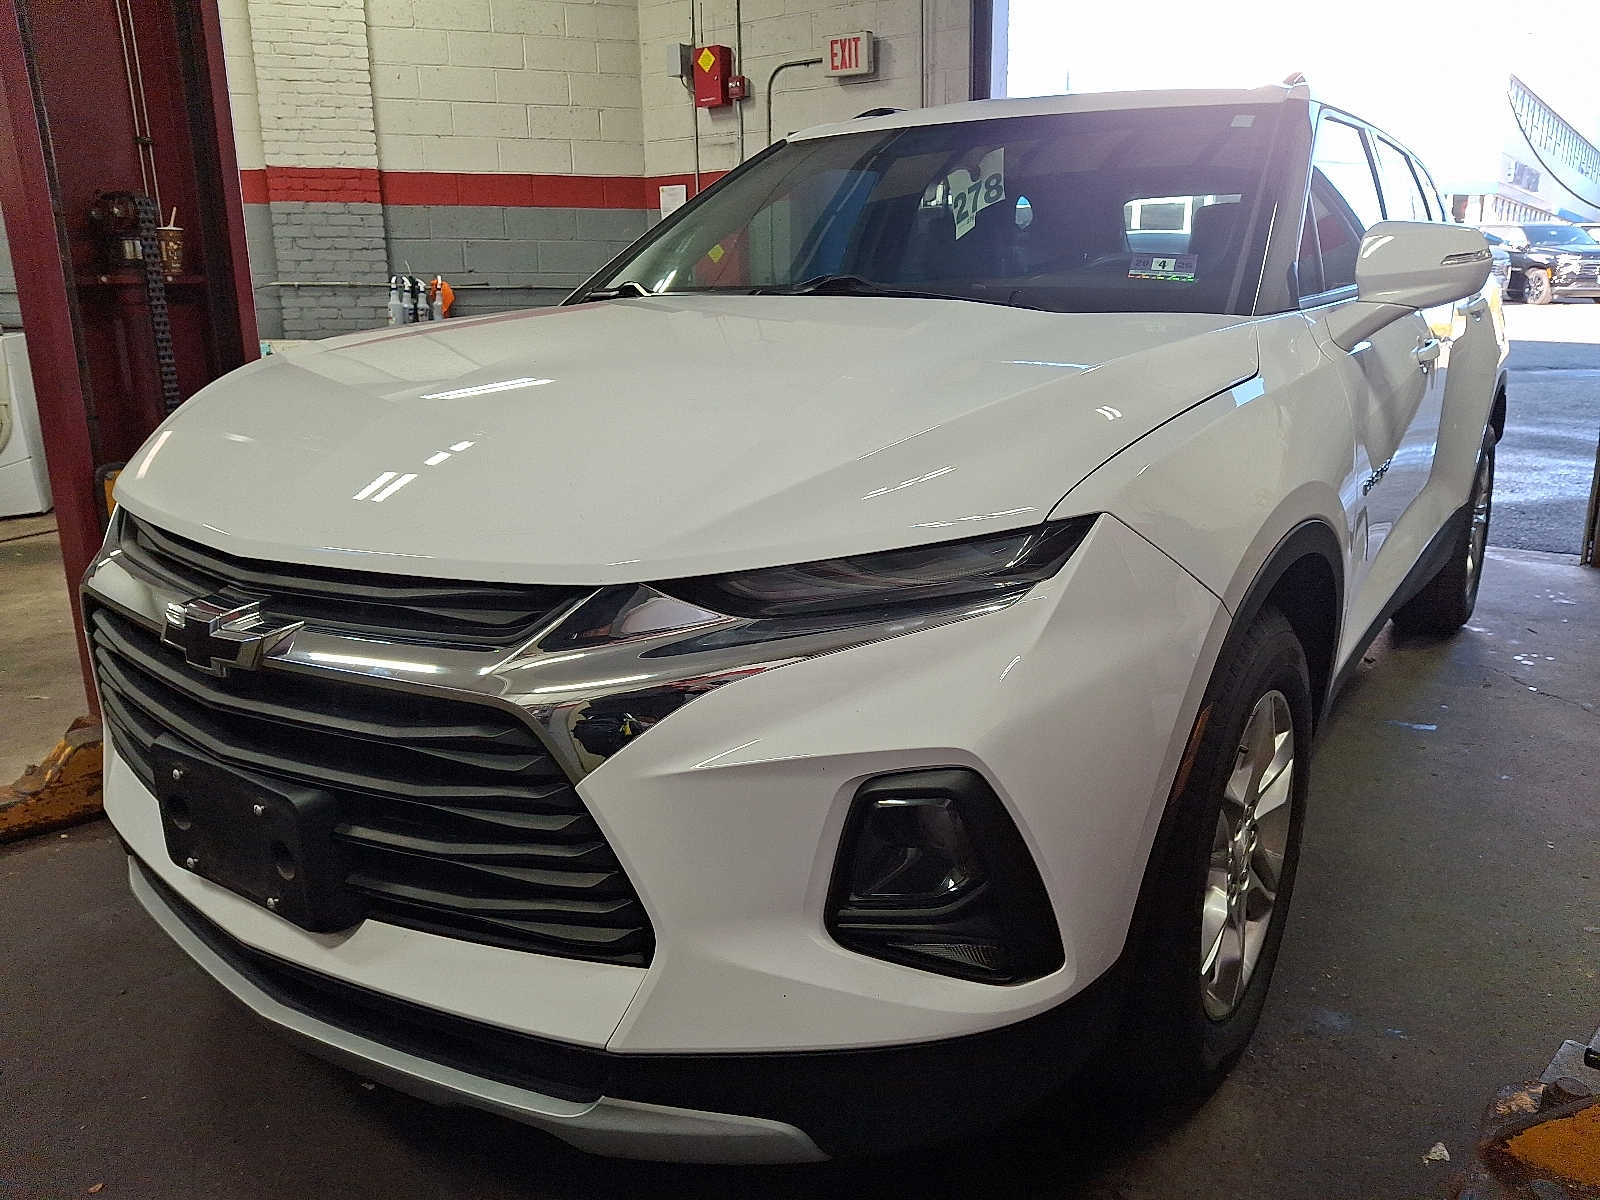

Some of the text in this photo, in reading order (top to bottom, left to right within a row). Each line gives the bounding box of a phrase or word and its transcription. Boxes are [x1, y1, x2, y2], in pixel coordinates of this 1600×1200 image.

[831, 37, 861, 70] EXIT
[954, 173, 1004, 225] 278
[1158, 260, 1167, 270] 4
